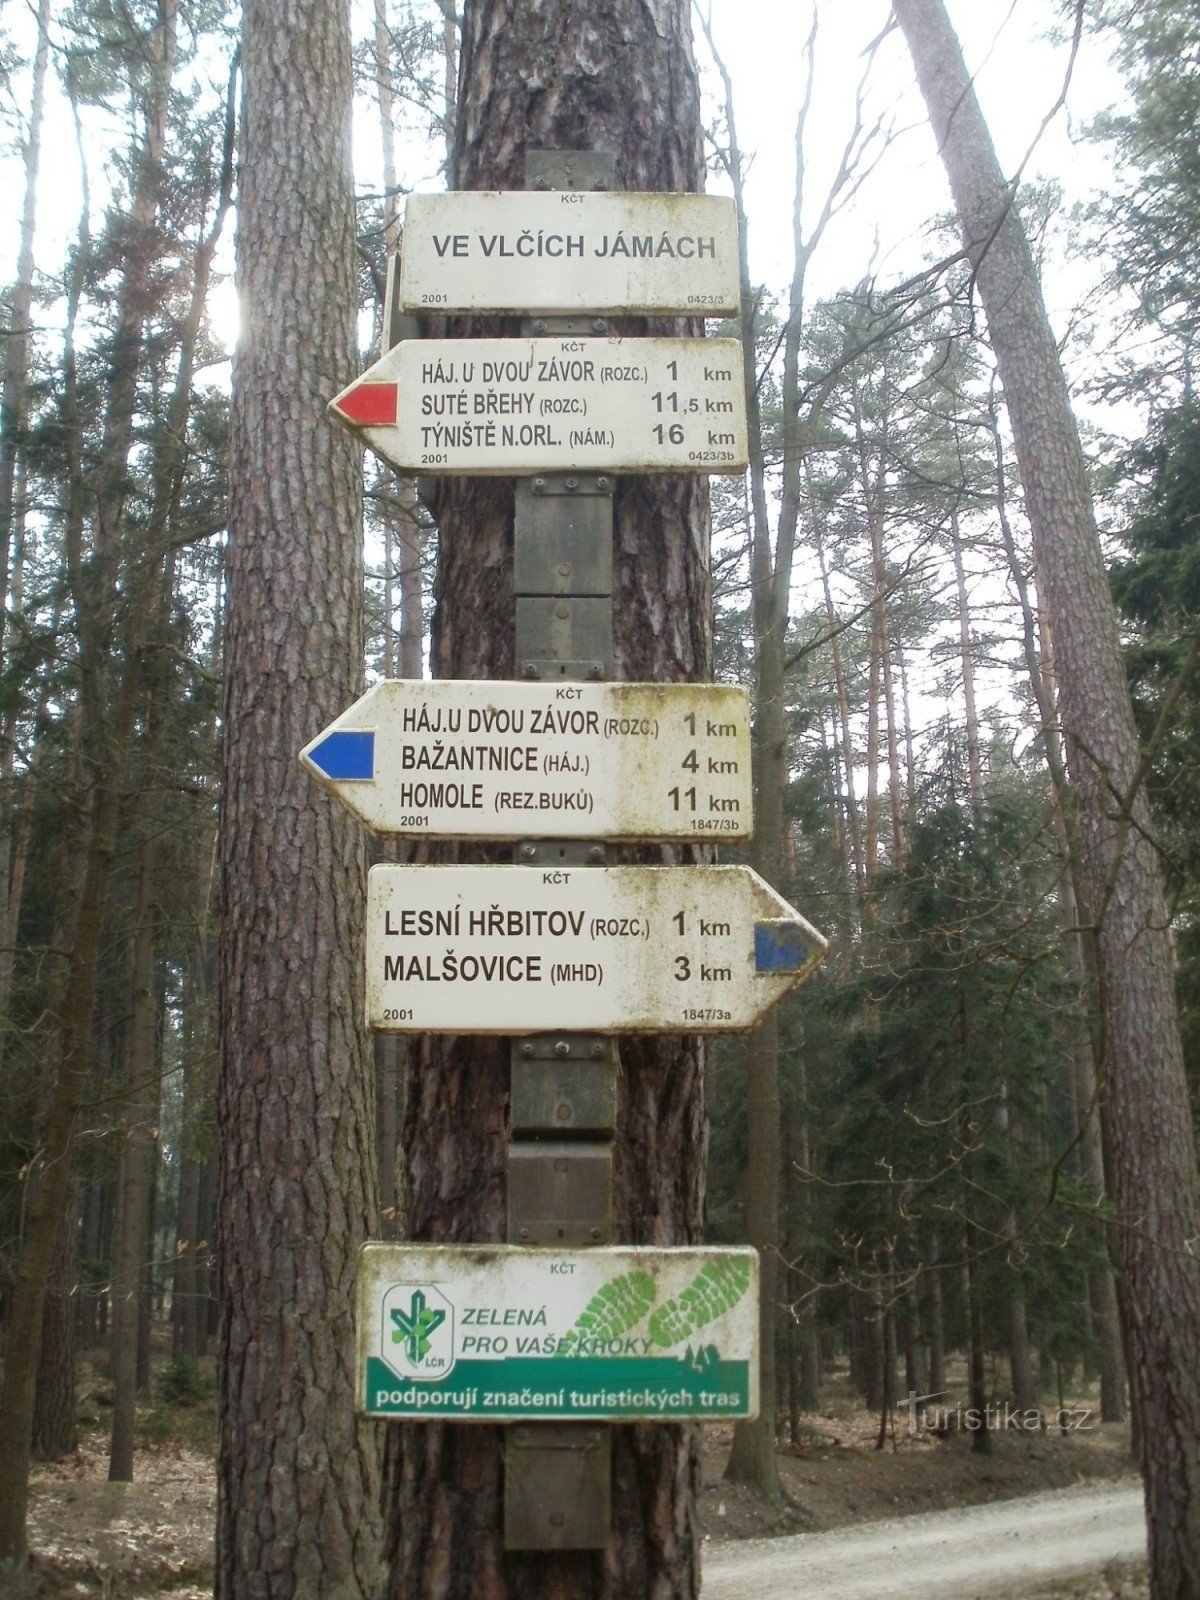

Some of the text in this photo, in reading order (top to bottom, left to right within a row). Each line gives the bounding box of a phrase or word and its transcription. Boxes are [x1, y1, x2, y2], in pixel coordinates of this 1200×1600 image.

[561, 194, 585, 204] KČT
[432, 229, 716, 258] VE VLČÍCH JÁMÁCH
[422, 294, 448, 303] 2001
[688, 295, 724, 304] 0423/3
[562, 342, 586, 352] KČT
[483, 362, 529, 382] DVOU
[538, 356, 594, 382] ZÁVOR
[600, 367, 648, 384] (ROZC.)
[666, 361, 678, 380] 1
[704, 367, 732, 380] km
[422, 389, 468, 415] SUTÉ
[474, 388, 534, 414] BŘEHY
[540, 399, 587, 416] (ROZC.)
[706, 398, 733, 412] km
[421, 420, 735, 448] TÝNIŠTĚ N.ORL. (NÁM.) 16 km
[422, 454, 448, 464] 2001
[689, 452, 734, 460] 0423/3b
[556, 688, 583, 700] KČT
[468, 710, 524, 734] DVOU
[530, 704, 600, 735] ZÁVOR
[604, 718, 659, 739] (ROZC.)
[684, 712, 696, 736] 1
[706, 720, 736, 736] km
[402, 740, 738, 776] BAŽANTNICE (HÁJ.) 4 km
[400, 783, 483, 809] HOMOLE
[667, 787, 696, 811] 11
[710, 796, 740, 812] km
[400, 816, 429, 826] 2001
[690, 819, 739, 830] 1847/3b
[543, 872, 571, 884] KČT
[385, 904, 730, 940] LESNÍ HŘBITOV (ROZC.) 1 km
[384, 950, 732, 986] MALŠOVICE (MHD) 3 km
[384, 1009, 414, 1020] 2001
[682, 1009, 731, 1021] 1847/3a
[550, 1263, 576, 1274] KČT
[461, 1305, 547, 1326] ZELENÁ
[461, 1334, 653, 1354] PRO VAŠE KROKY
[376, 1386, 740, 1410] podporují značení turistických tras
